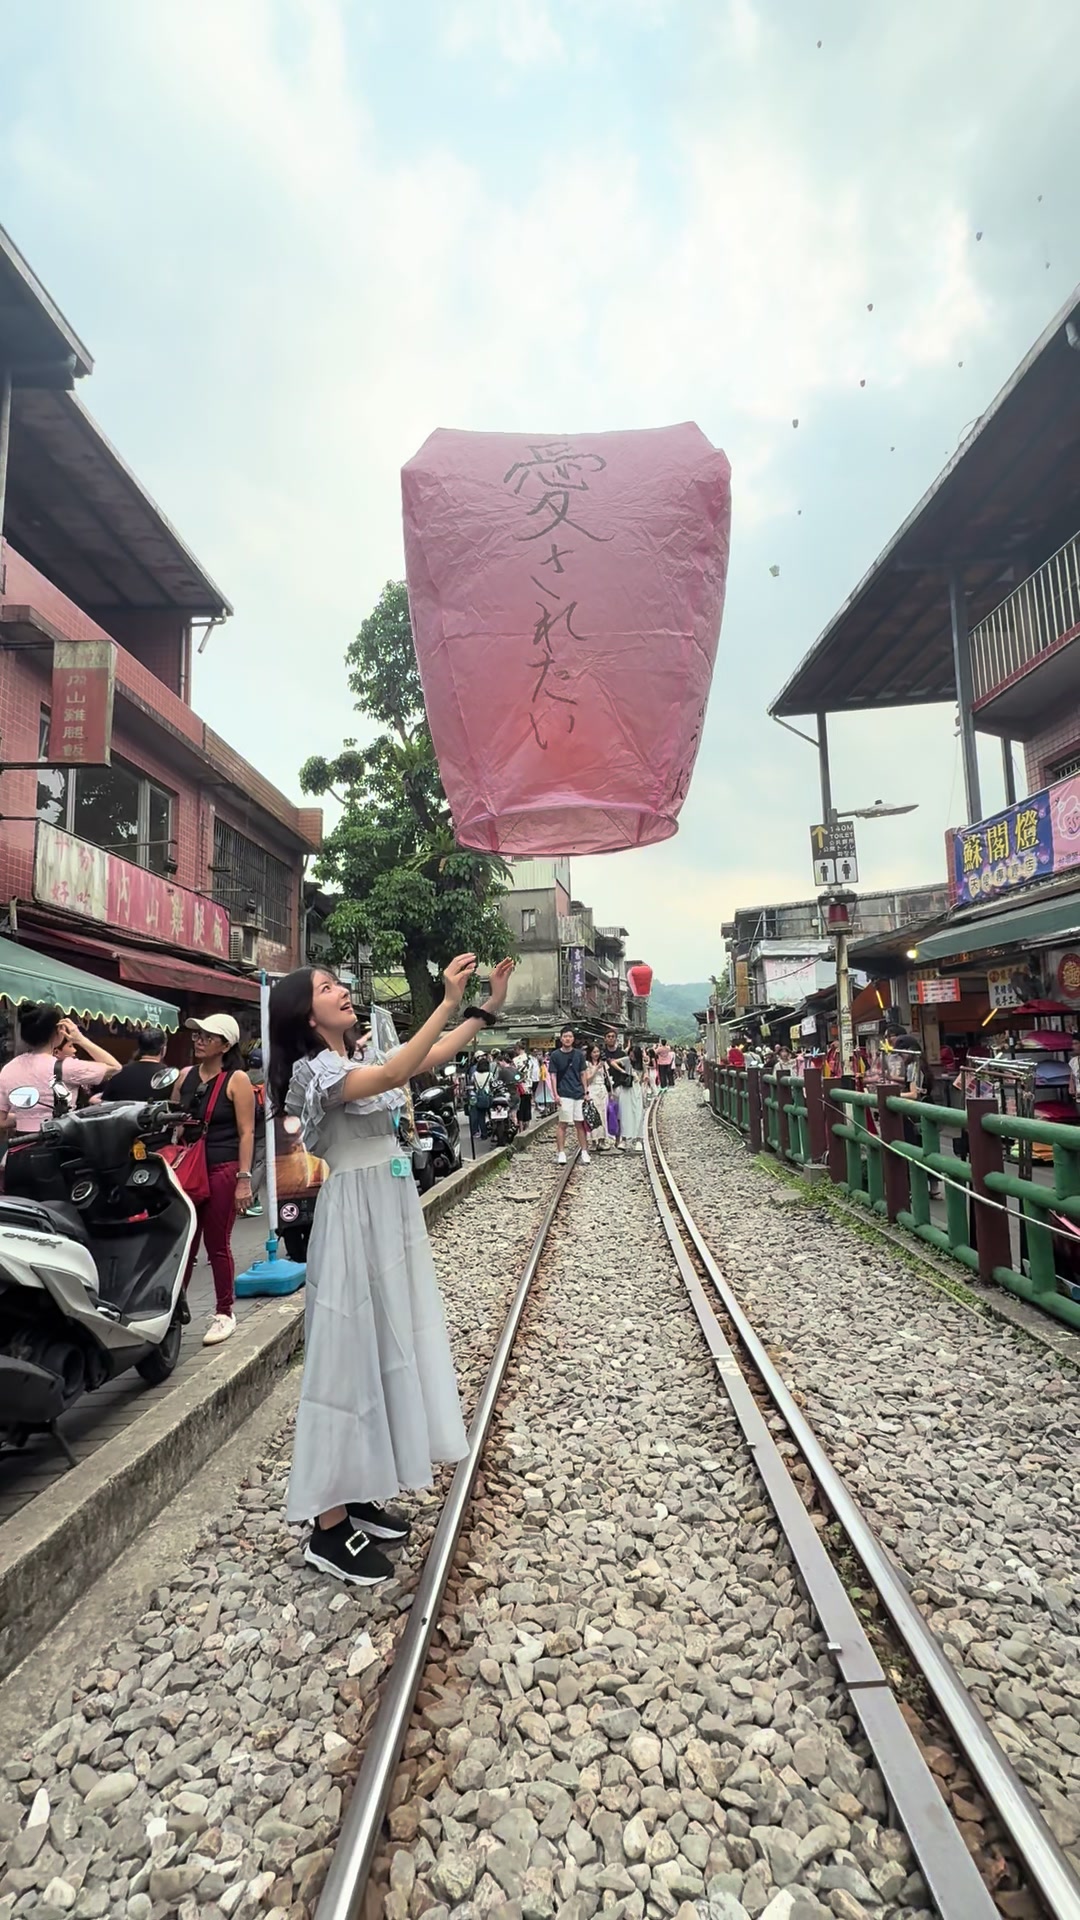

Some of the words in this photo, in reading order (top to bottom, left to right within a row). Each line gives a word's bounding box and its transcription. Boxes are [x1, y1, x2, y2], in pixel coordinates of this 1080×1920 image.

[503, 441, 615, 751] 愛されたい
[829, 832, 853, 840] TOILET
[963, 808, 1040, 874] 蘇閣燈
